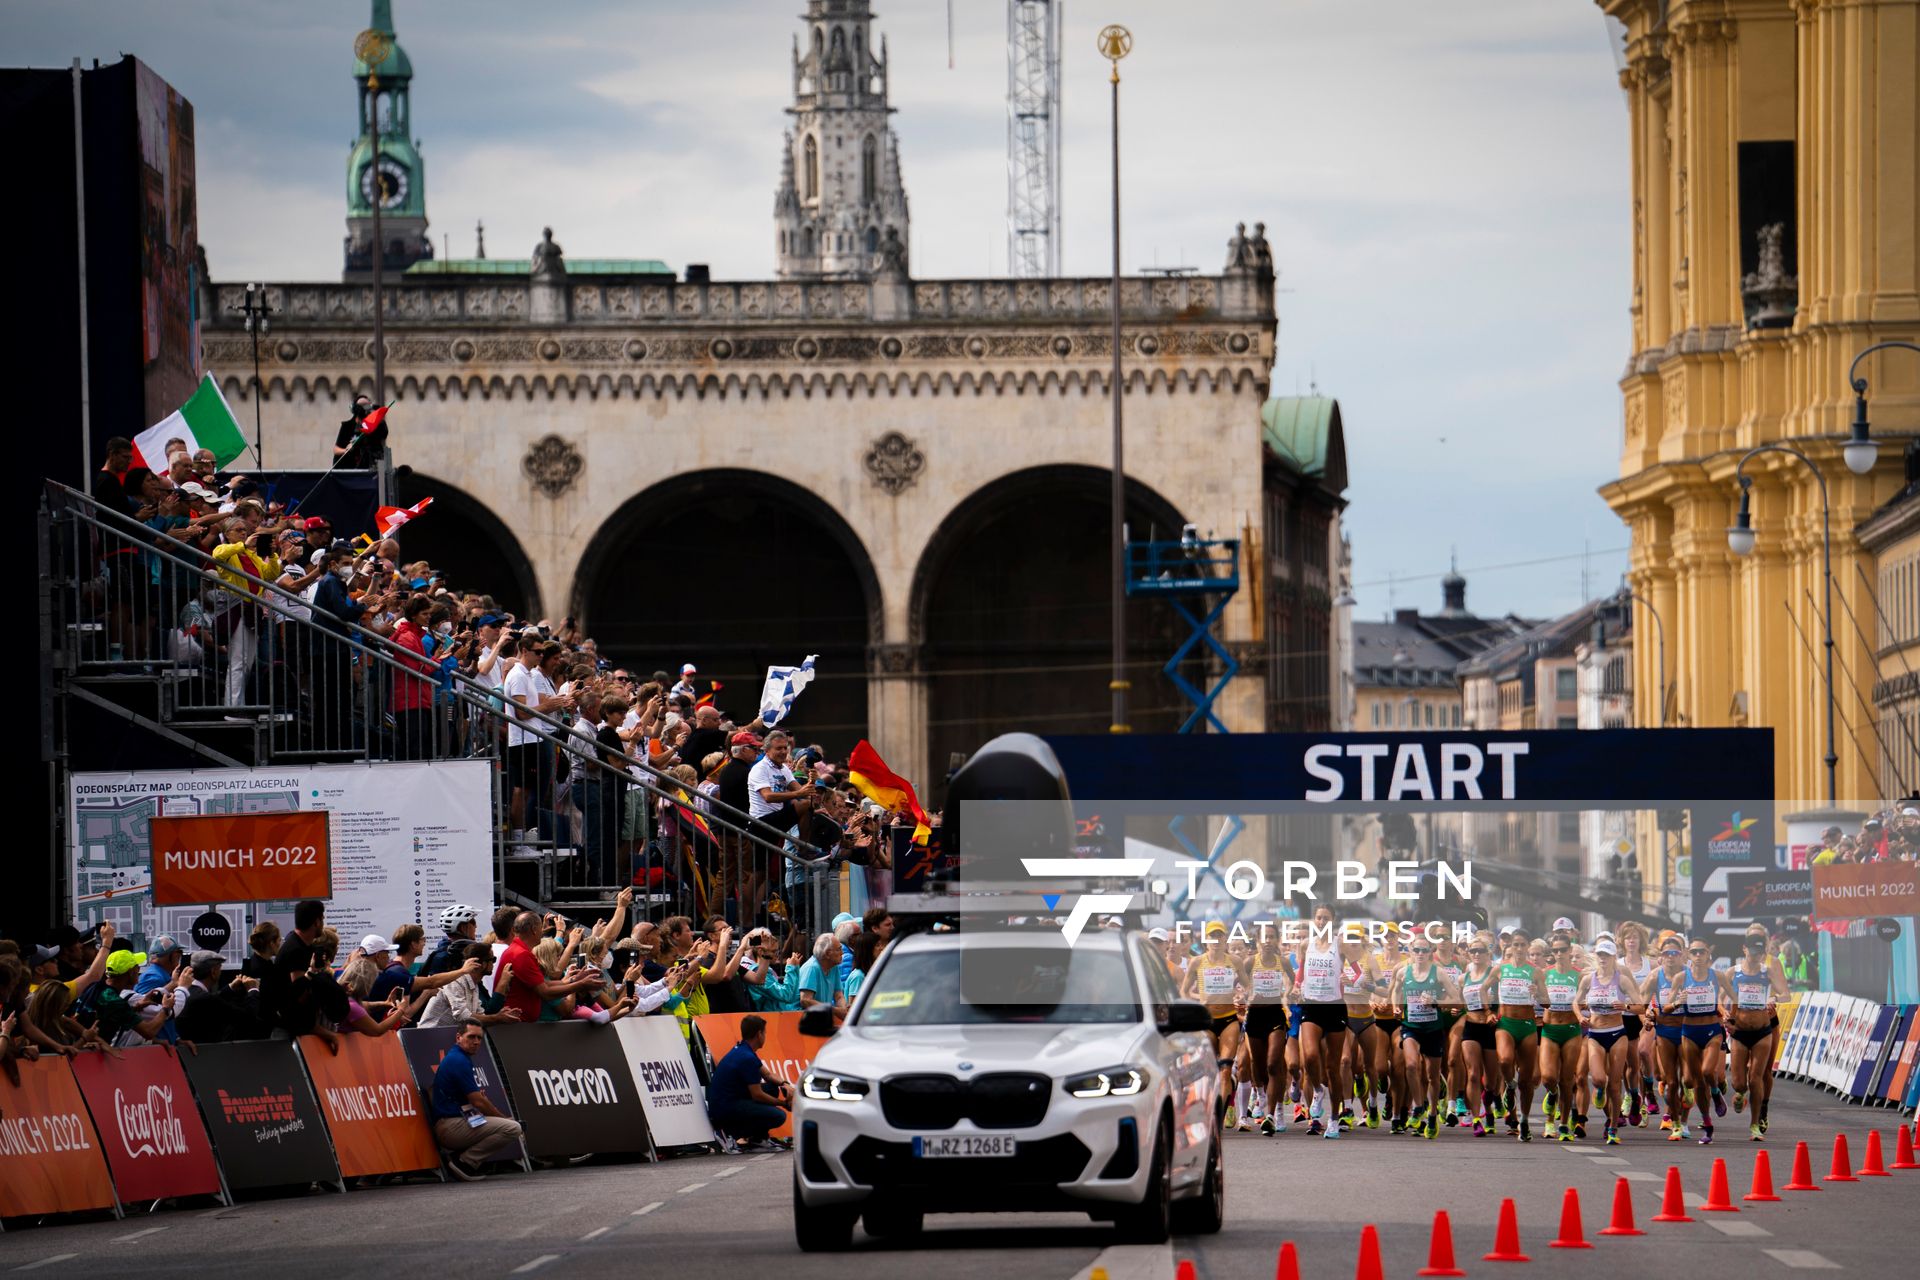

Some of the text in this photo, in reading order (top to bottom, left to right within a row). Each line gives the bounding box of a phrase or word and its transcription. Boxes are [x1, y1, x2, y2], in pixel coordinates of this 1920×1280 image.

[176, 778, 299, 791] ODEONSPLATZ LAGEPLAN
[1303, 742, 1530, 803] START
[76, 783, 172, 795] ODEONSPLATZ MAP
[164, 845, 317, 871] MUNICH 2022
[1819, 882, 1915, 900] MUNICH 2022
[197, 926, 225, 938] 100m
[527, 1067, 618, 1106] macron
[639, 1059, 690, 1093] BORNAN
[325, 1083, 416, 1122] MUNICH 2022
[0, 1114, 90, 1156] UNICH 2022
[921, 1139, 932, 1155] M
[941, 1138, 960, 1155] RZ
